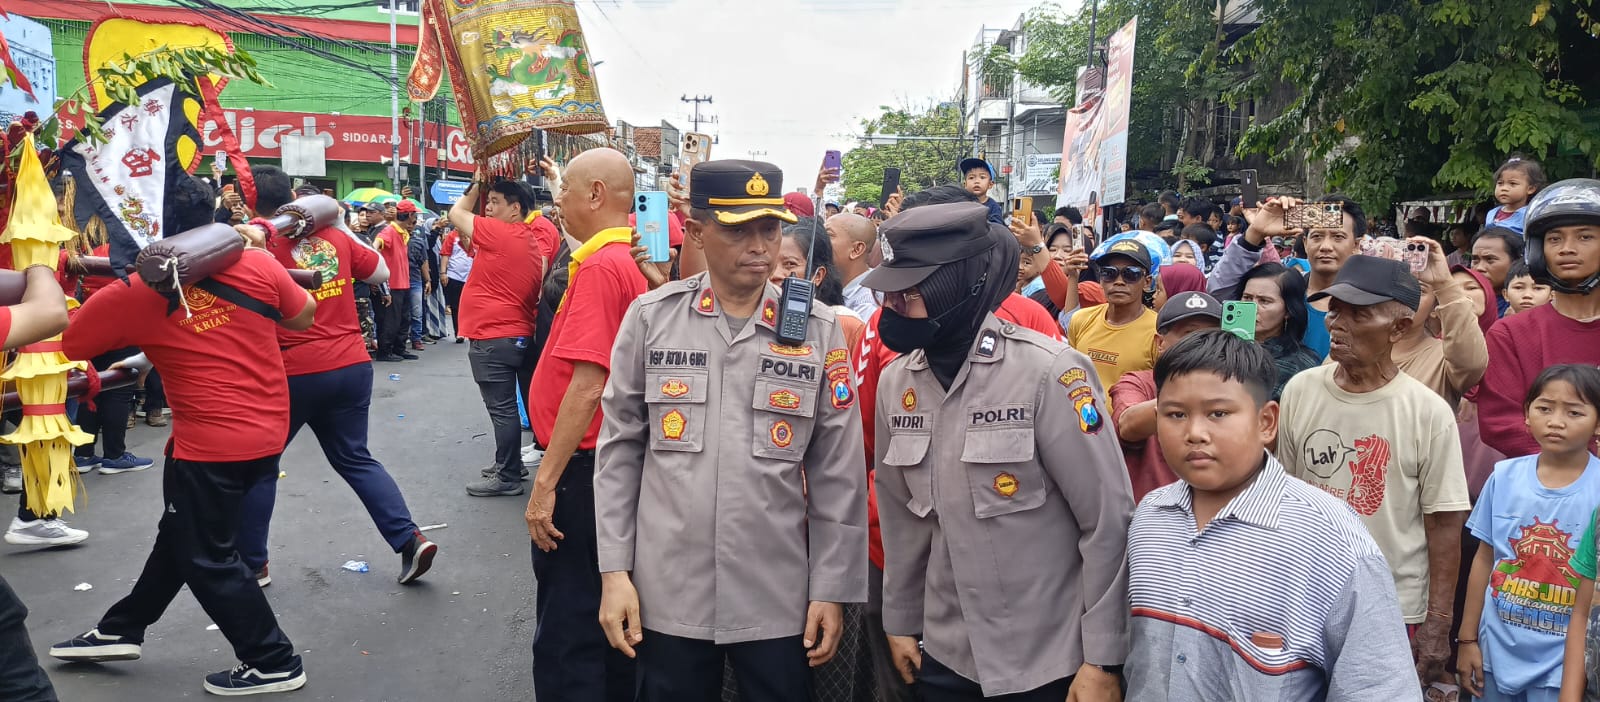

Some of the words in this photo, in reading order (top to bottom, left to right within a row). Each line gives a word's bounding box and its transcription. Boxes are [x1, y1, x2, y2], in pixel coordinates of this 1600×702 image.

[193, 313, 231, 333] KRIAN
[761, 358, 816, 380] POLRI
[891, 415, 924, 429] INDRI
[972, 407, 1025, 425] POLRI
[1501, 574, 1577, 607] MASJID
